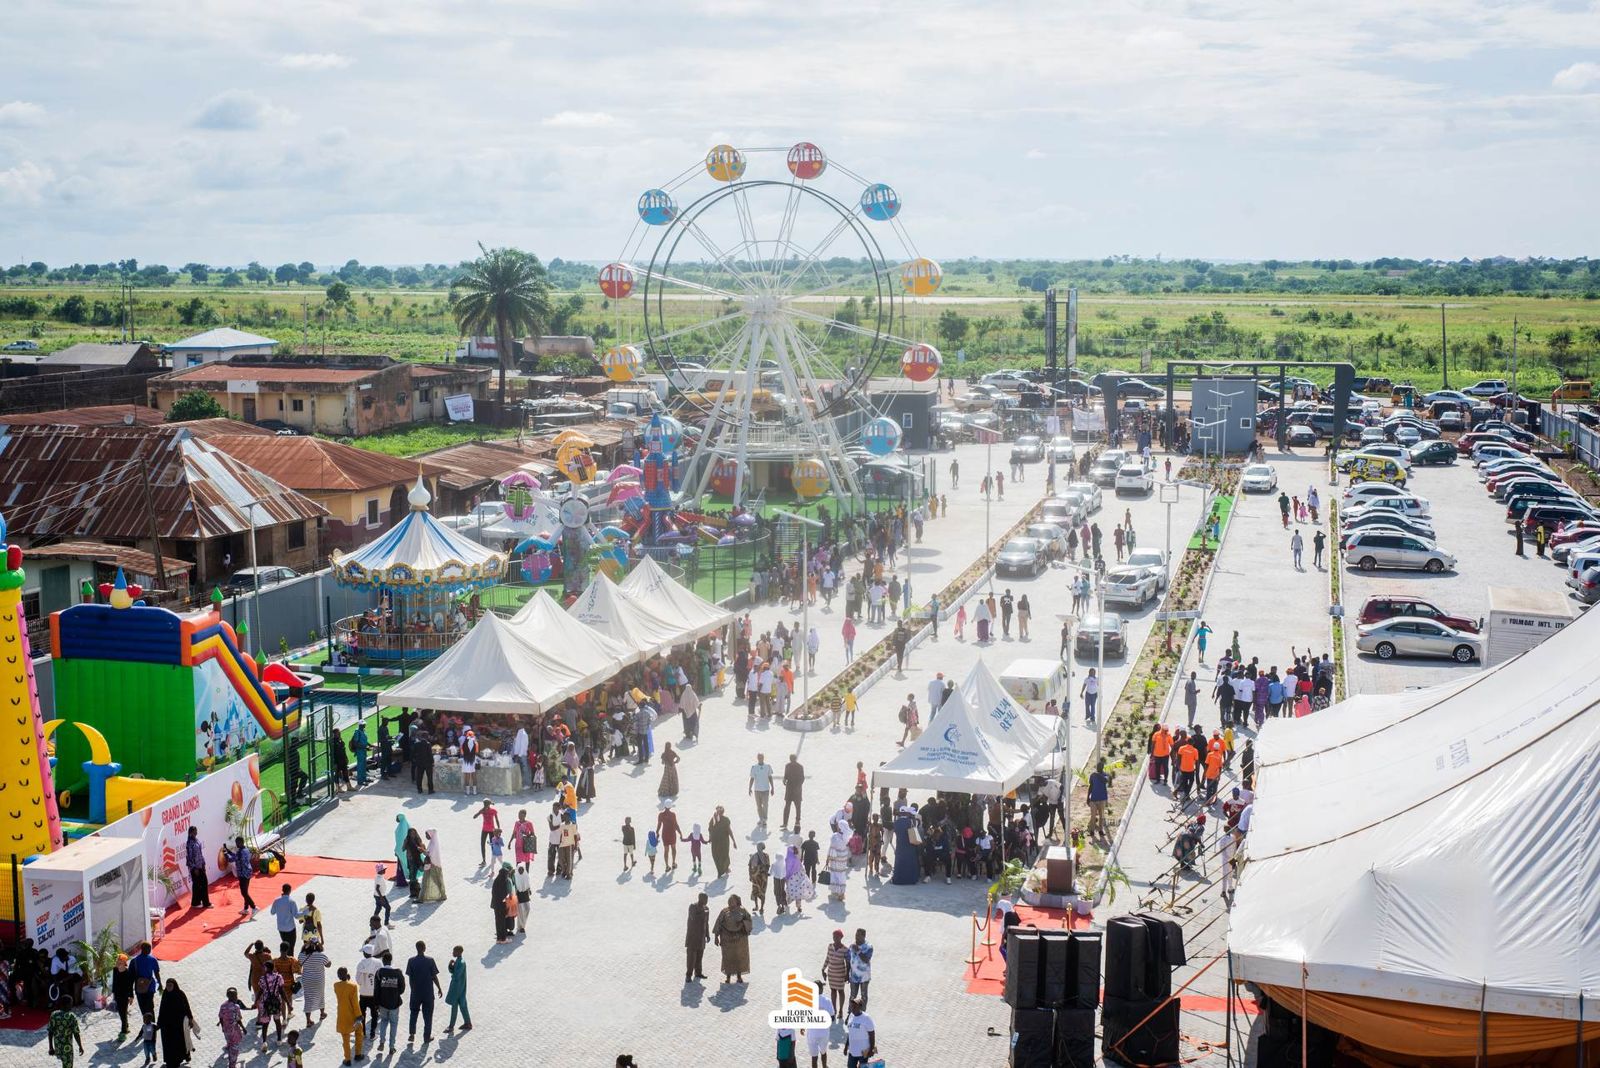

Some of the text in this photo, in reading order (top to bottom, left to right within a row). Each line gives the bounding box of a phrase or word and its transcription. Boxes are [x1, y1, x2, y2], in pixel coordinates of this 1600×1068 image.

[162, 795, 200, 825] GRAND LAUNCH
[174, 815, 190, 836] PARTY
[36, 911, 50, 926] SHOP
[37, 922, 48, 936] EAT
[38, 927, 56, 946] ENJOY
